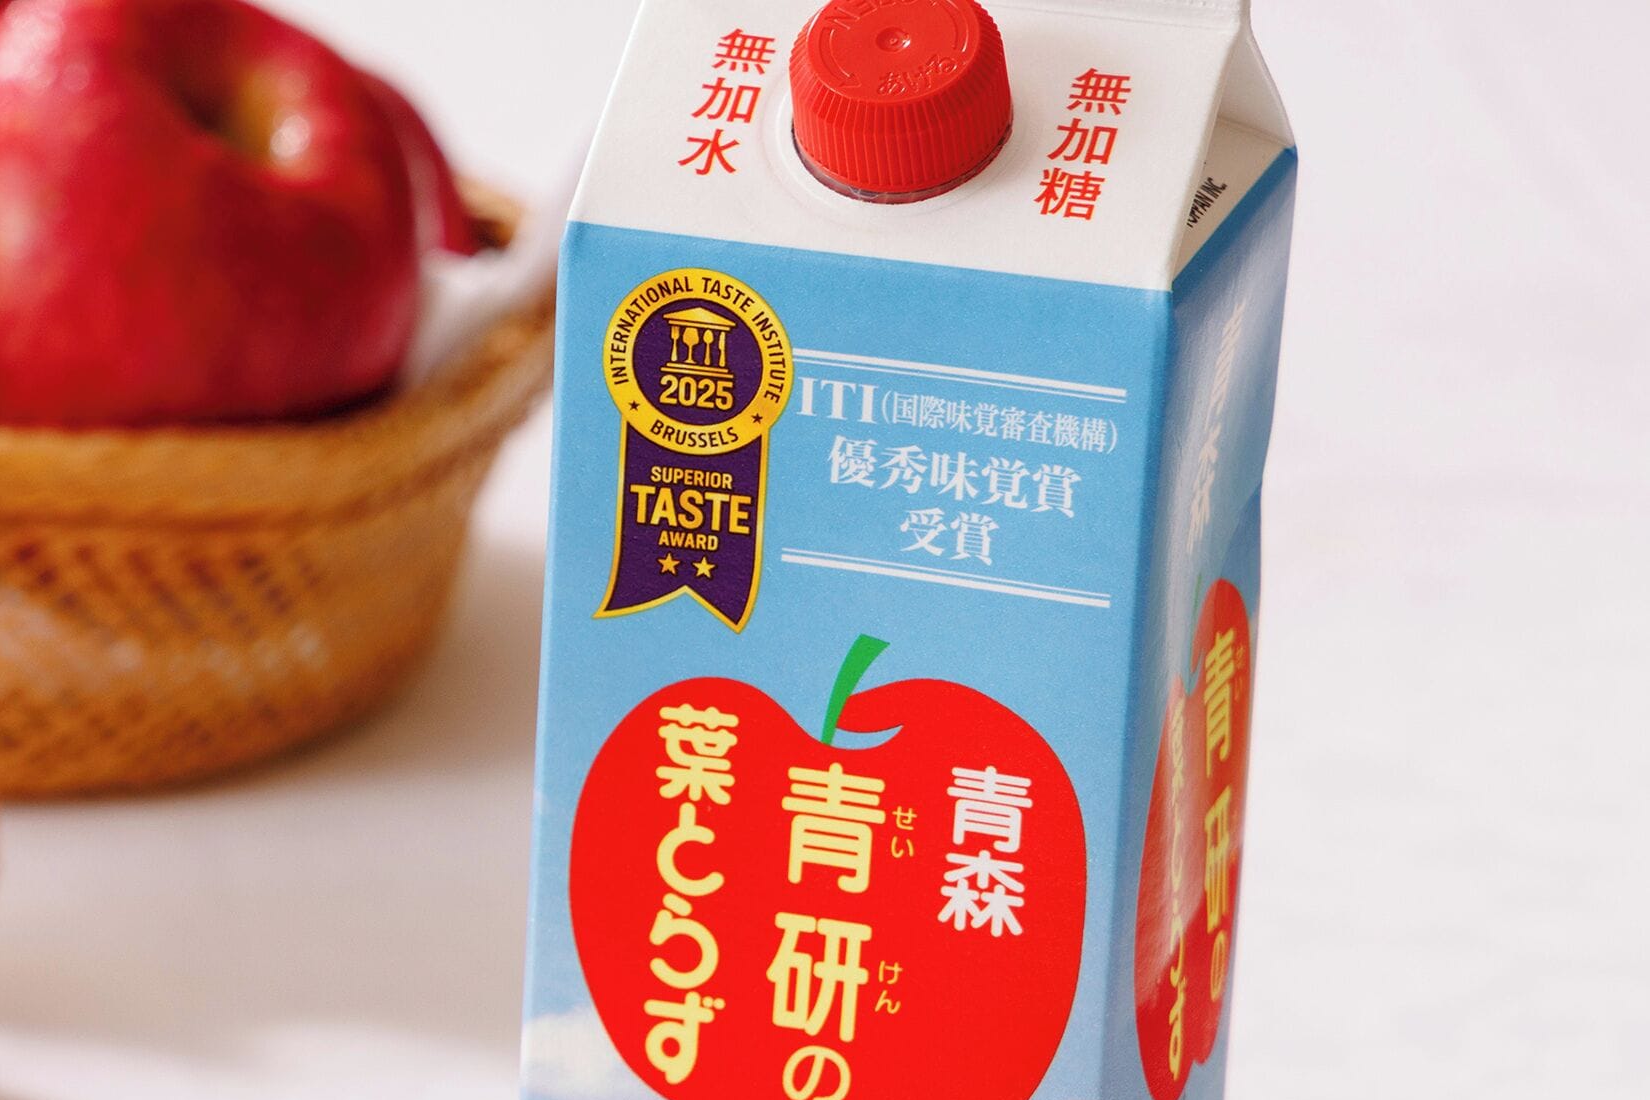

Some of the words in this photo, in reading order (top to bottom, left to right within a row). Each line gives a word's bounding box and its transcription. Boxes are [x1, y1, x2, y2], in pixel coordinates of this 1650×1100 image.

[678, 28, 776, 175] 無加水
[1034, 67, 1132, 220] 無加糖
[610, 276, 694, 386] INTERNATIONAL
[701, 276, 756, 314] TASTE
[752, 310, 786, 404] INSTITUTE
[659, 374, 734, 411] 2025
[650, 419, 739, 448] BRUSSELS
[650, 465, 733, 490] SUPERIOR
[827, 434, 1082, 519] 優秀味覚賞
[629, 483, 752, 535] TASTE
[899, 507, 1000, 567] 受賞
[658, 530, 719, 551] AWARD
[891, 804, 919, 860] せい
[937, 764, 1034, 938] 青森
[644, 703, 739, 1085] 葉とらず
[874, 959, 903, 1016] けん
